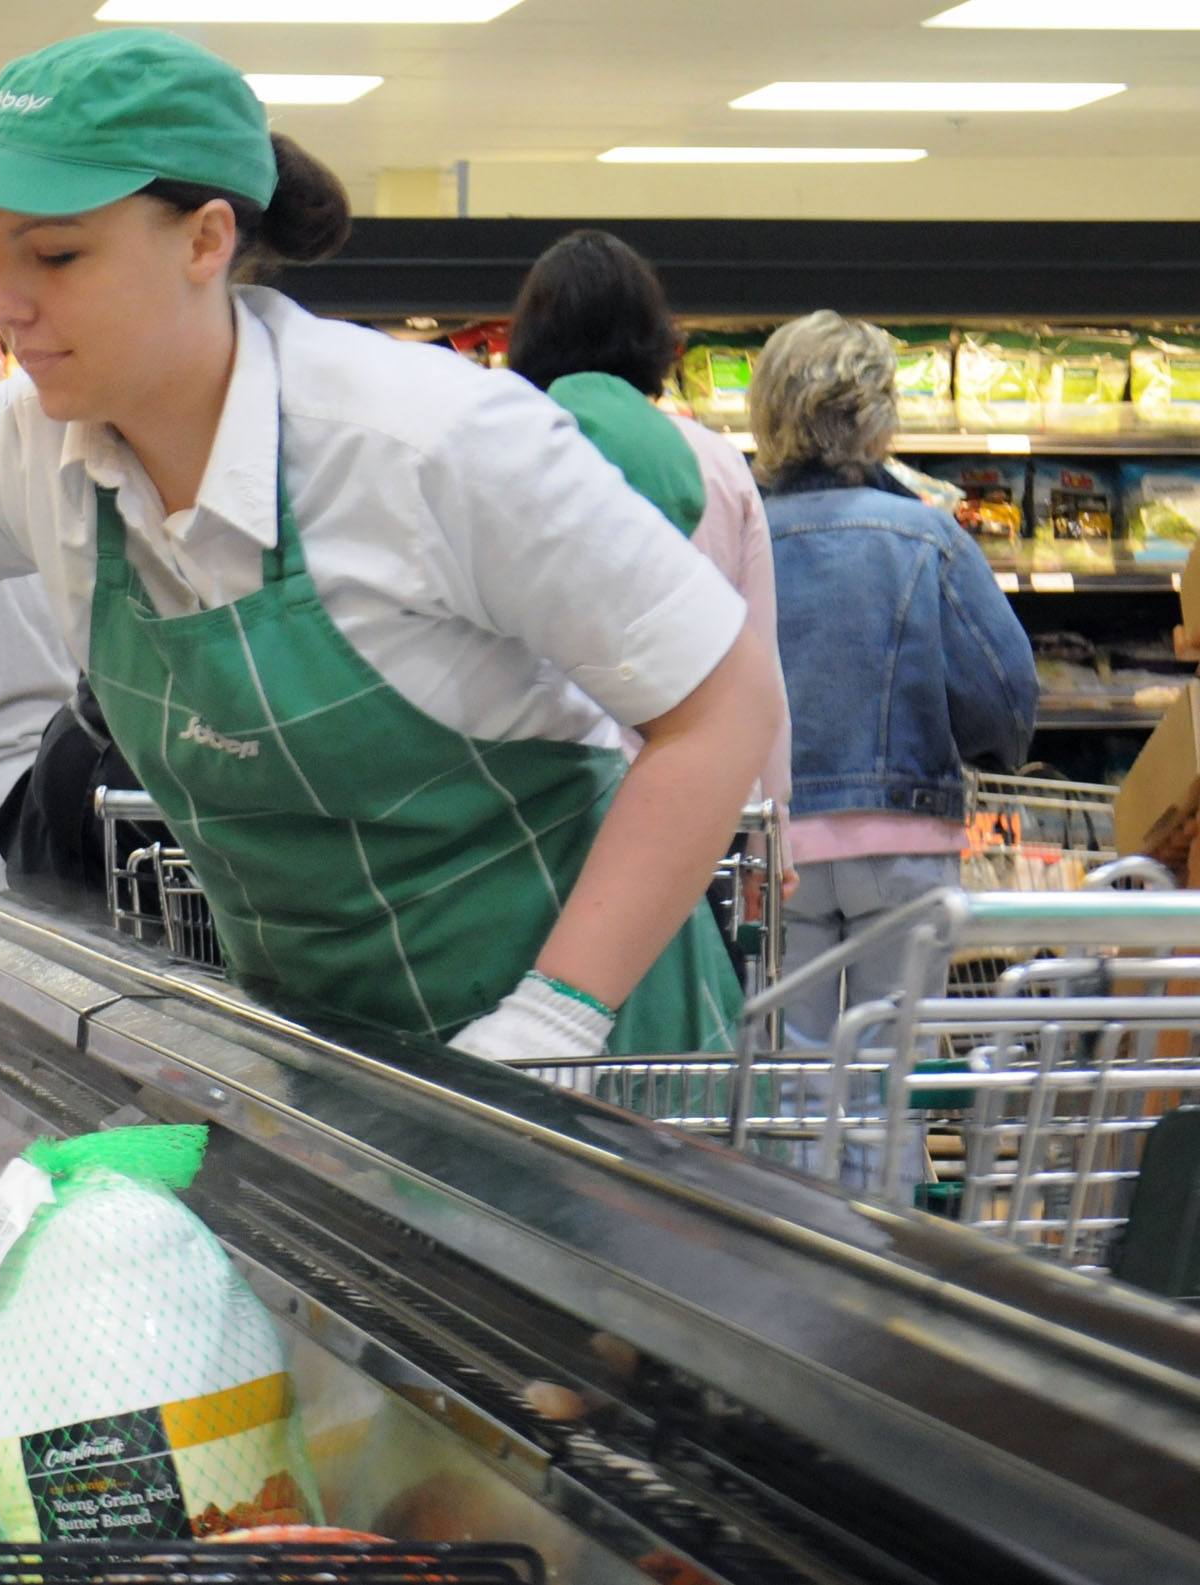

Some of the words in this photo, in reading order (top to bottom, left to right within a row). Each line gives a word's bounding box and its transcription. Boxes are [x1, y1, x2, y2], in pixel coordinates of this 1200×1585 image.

[52, 1499, 99, 1515] Young,
[101, 1493, 144, 1509] Grain
[144, 1483, 180, 1503] Fed,
[56, 1517, 99, 1531] Butter
[101, 1507, 152, 1529] Basted
